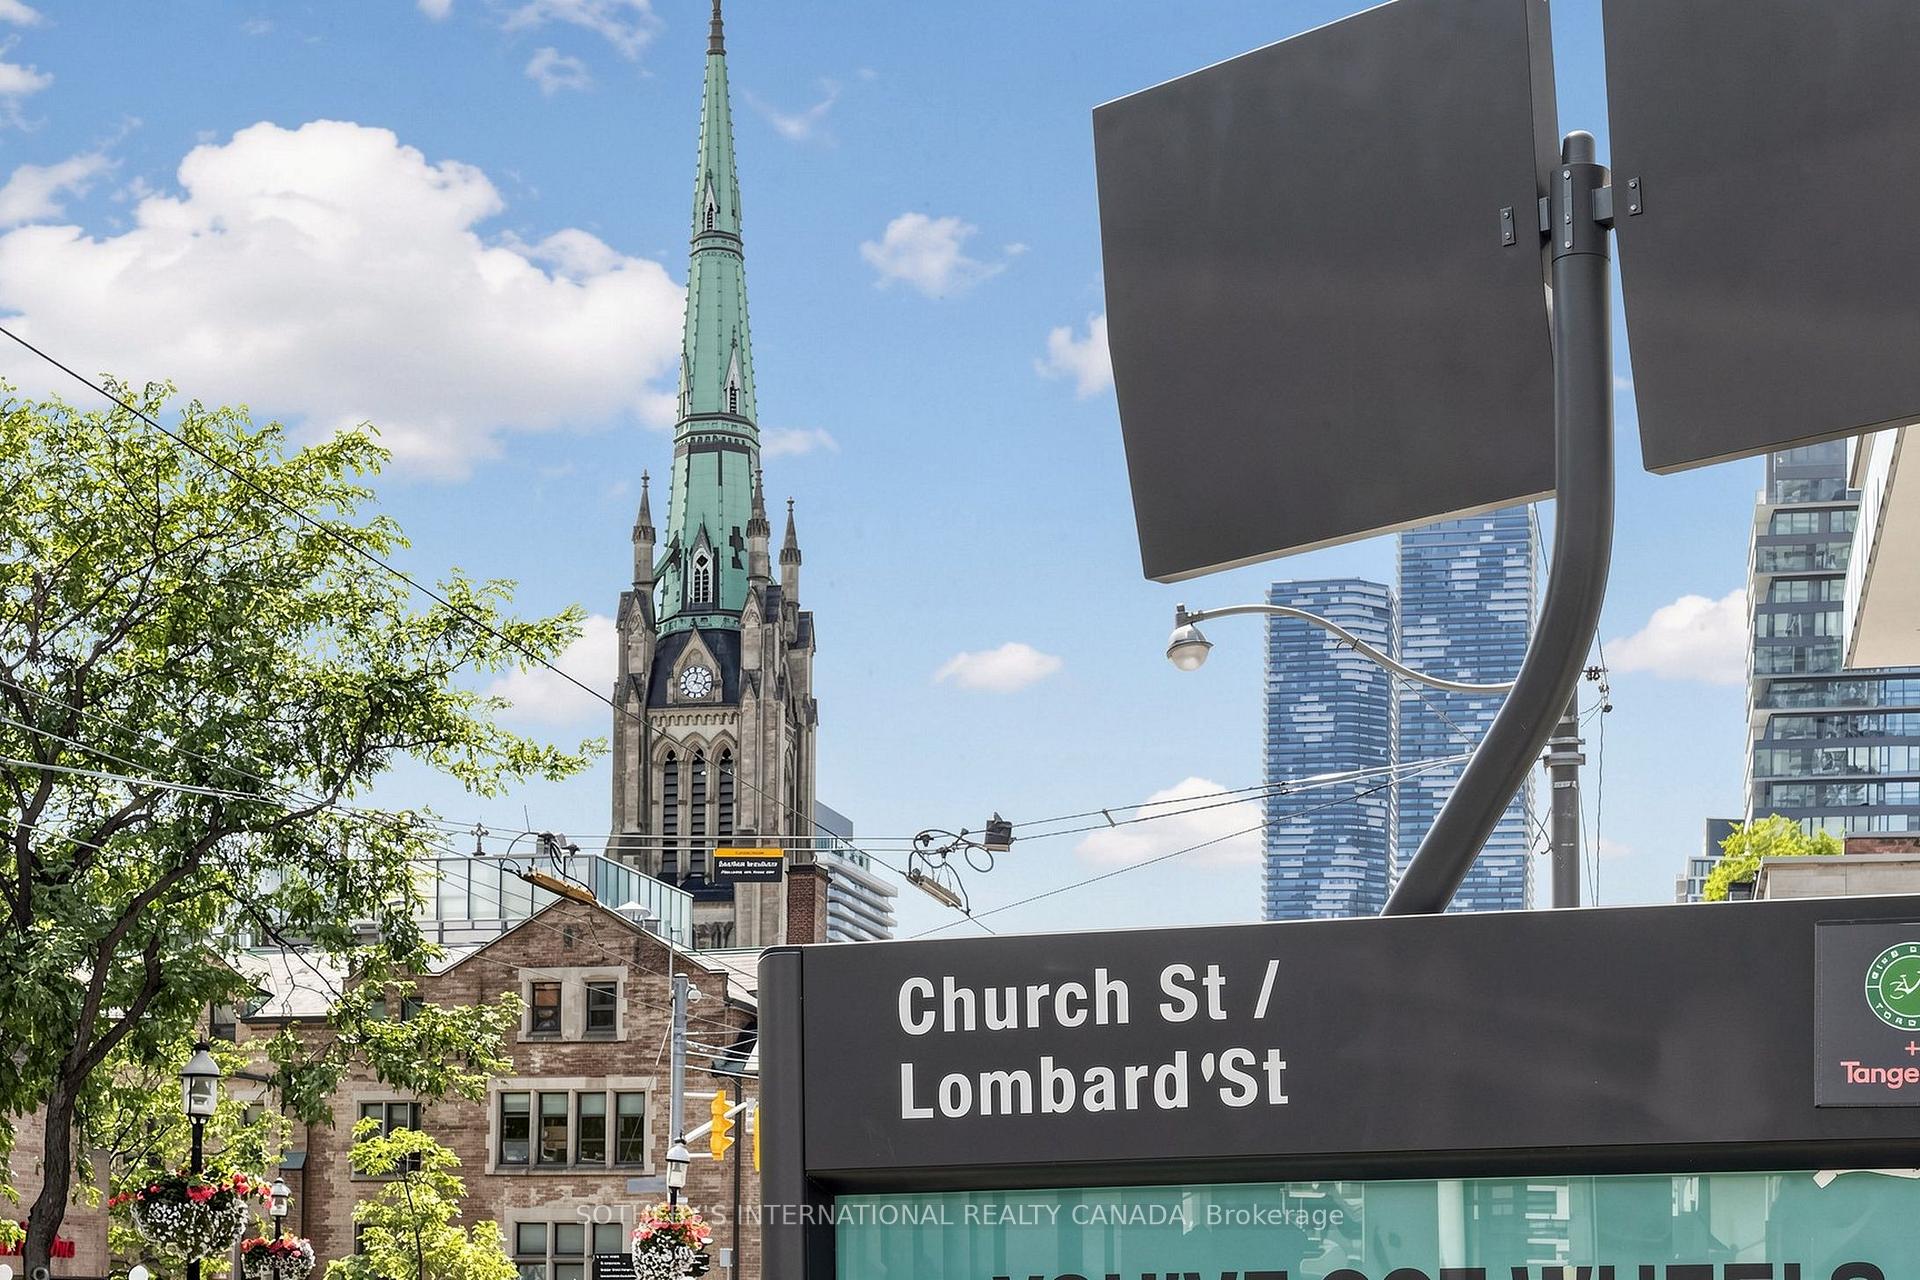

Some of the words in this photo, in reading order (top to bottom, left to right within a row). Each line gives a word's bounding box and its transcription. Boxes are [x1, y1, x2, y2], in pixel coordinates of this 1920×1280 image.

[898, 967, 1130, 1036] Church
[1159, 963, 1227, 1023] St
[1253, 959, 1280, 1019] /
[900, 1050, 1189, 1120] Lombard
[1840, 1061, 1920, 1090] Tange
